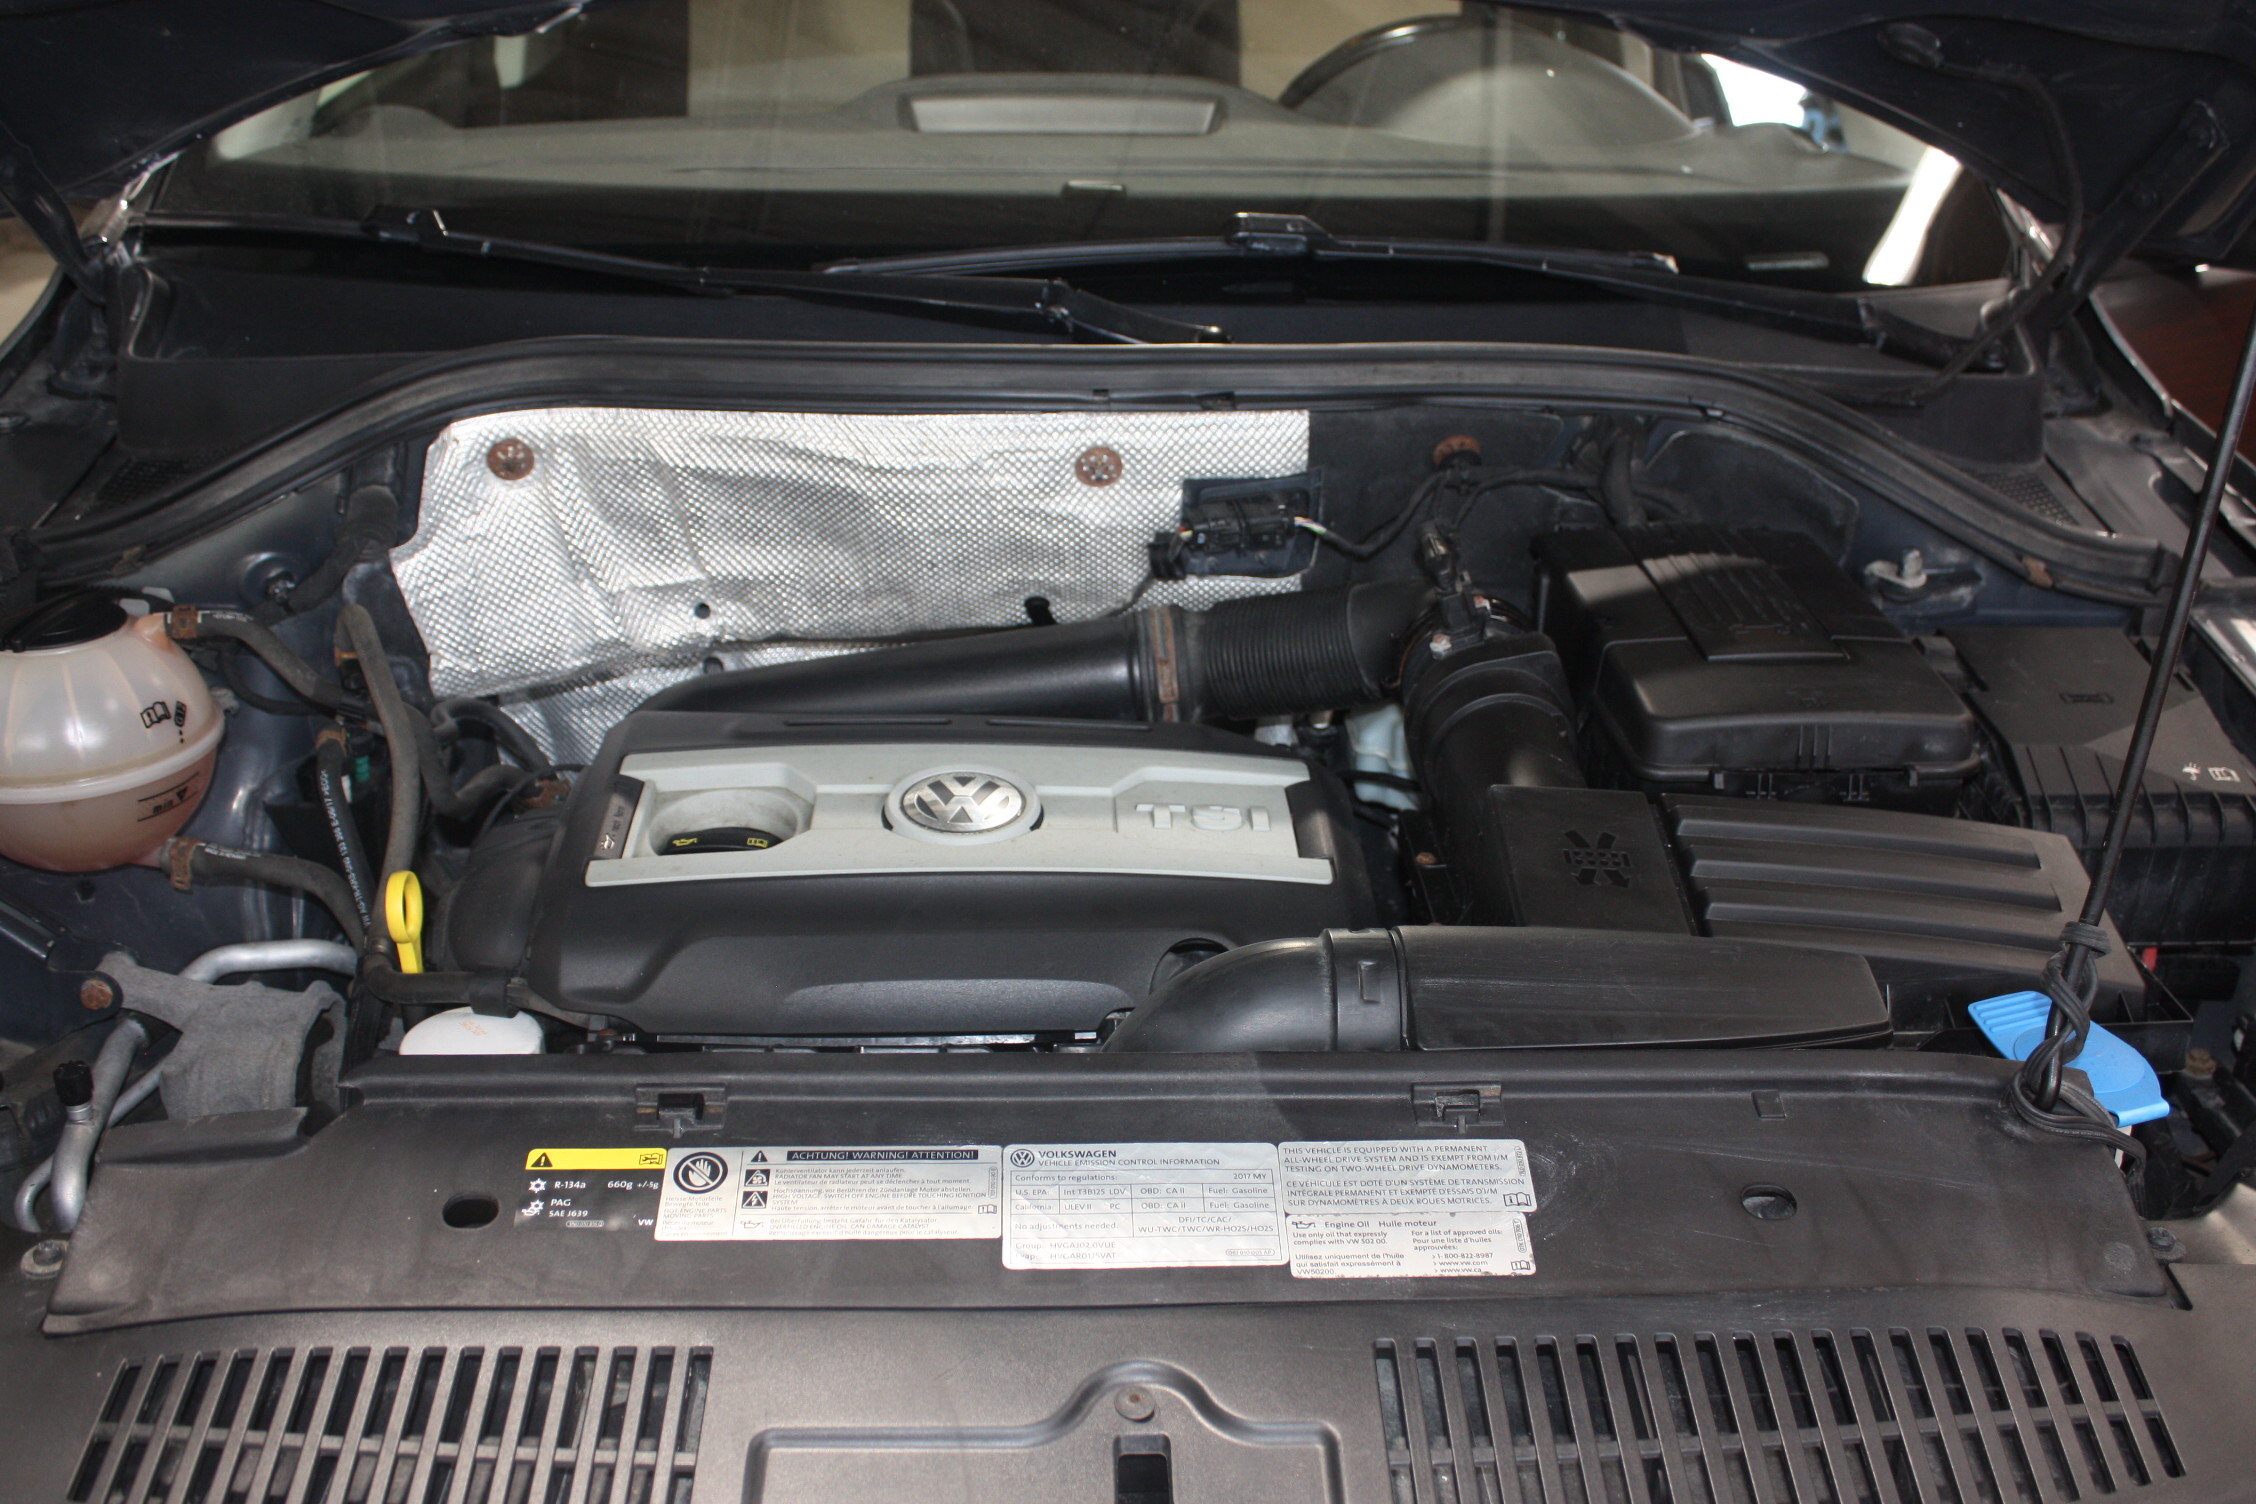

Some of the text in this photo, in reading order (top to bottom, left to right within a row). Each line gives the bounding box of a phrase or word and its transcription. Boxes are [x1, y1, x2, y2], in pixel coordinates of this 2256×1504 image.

[901, 772, 1025, 833] VW
[153, 800, 173, 815] min
[1136, 804, 1270, 831] TSI
[1038, 1150, 1117, 1158] VOLKSWAGEN
[1354, 1147, 1398, 1155] EQUIPPED
[792, 1151, 974, 1160] ACHTUNG! WARNING! ATTENTION!
[1068, 1174, 1118, 1182] regulations:
[554, 1181, 586, 1189] R-134a
[607, 1181, 633, 1190] 660g
[1360, 1179, 1383, 1187] DOTÉ
[1287, 1188, 1333, 1197] INTÉGRALE
[1335, 1189, 1386, 1197] PERMANENT
[1400, 1187, 1437, 1195] EXEMPTÉ
[550, 1198, 572, 1207] PAG
[1325, 1221, 1355, 1229] Engine
[1353, 1231, 1388, 1239] expressly
[1453, 1229, 1487, 1237] approved
[1325, 1253, 1369, 1261] uniquement
